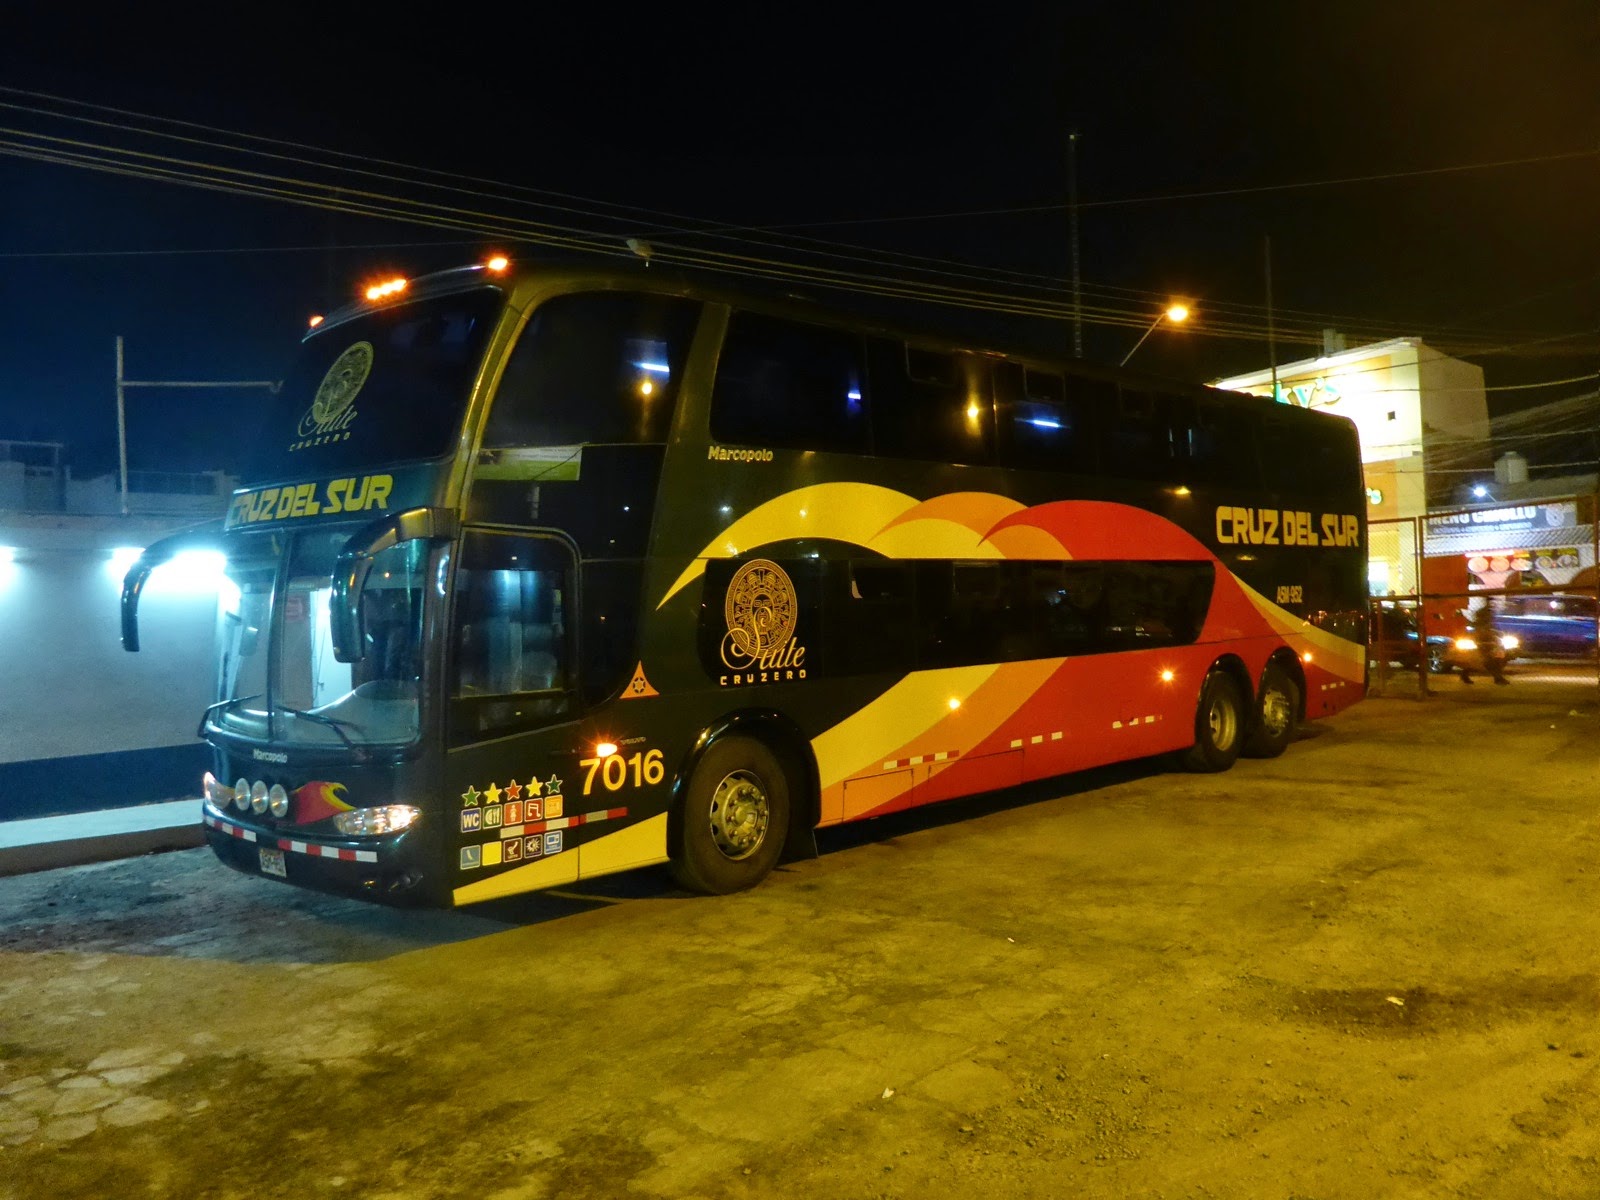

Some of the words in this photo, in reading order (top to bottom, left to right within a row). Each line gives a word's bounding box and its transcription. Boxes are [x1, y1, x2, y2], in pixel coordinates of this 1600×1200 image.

[708, 445, 774, 462] Marcopolo
[228, 487, 280, 527] CRUZ
[276, 482, 320, 519] DEL
[322, 474, 393, 514] SUR
[1216, 505, 1280, 545] CRUZ
[1282, 510, 1319, 546] DEL
[1321, 513, 1359, 547] SUR
[721, 606, 805, 670] Suite
[720, 669, 807, 686] CRUZERO
[253, 748, 288, 764] Marcopolo
[580, 749, 664, 795] 7016
[463, 813, 480, 828] WC
